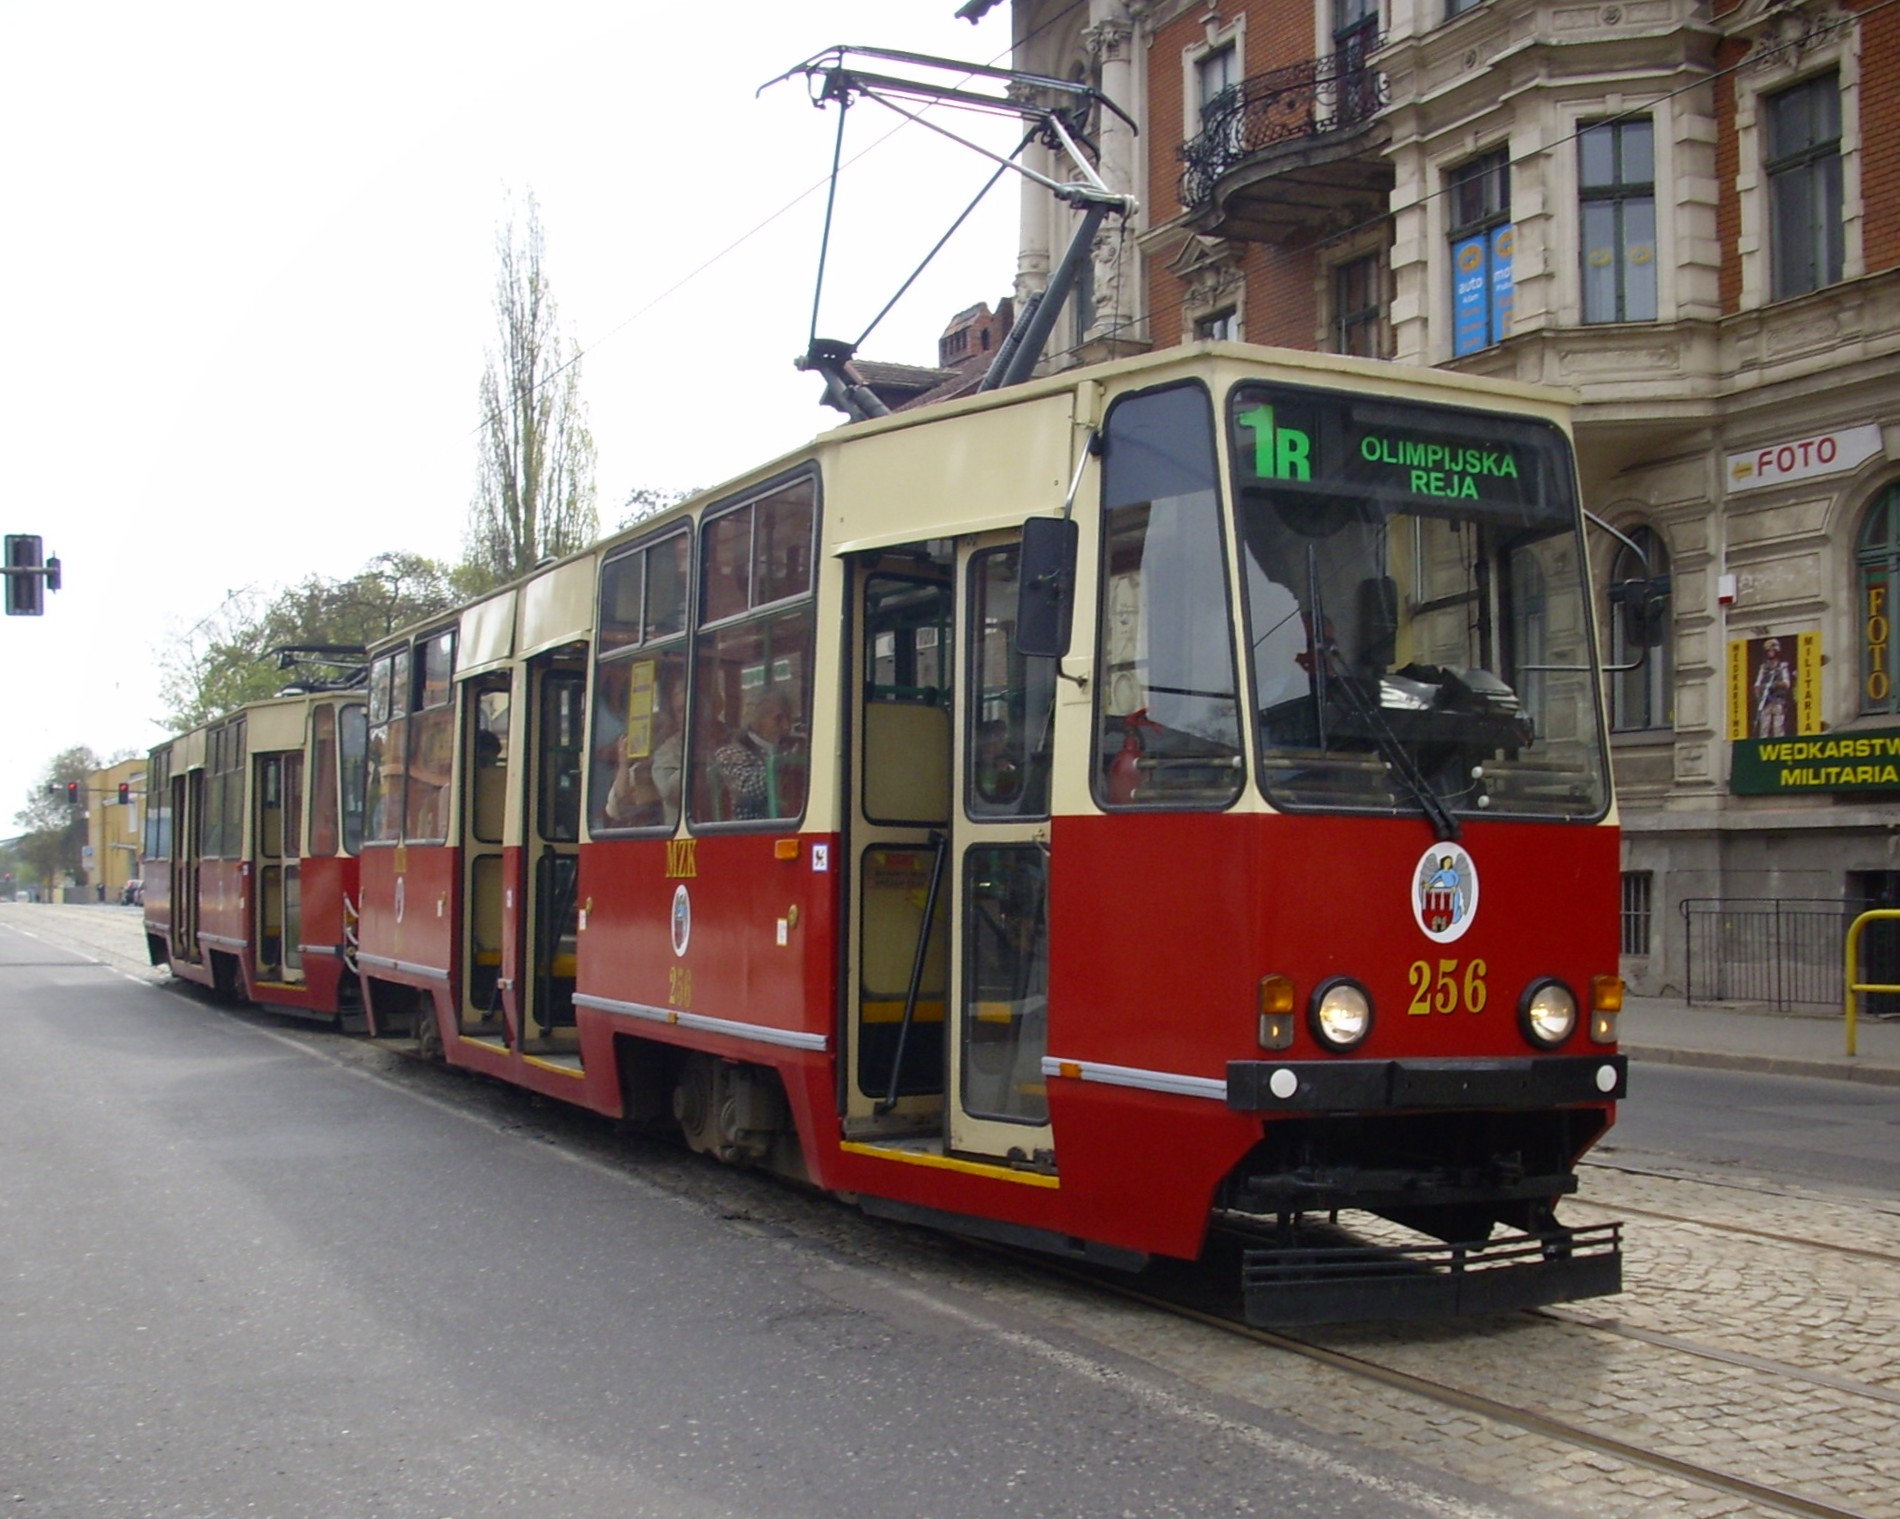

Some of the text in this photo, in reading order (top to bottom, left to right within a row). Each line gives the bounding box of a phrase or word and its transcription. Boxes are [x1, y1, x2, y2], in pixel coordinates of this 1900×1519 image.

[1458, 276, 1483, 294] auto
[1238, 404, 1311, 482] 1R
[1361, 436, 1519, 479] OLIMPIJSKA
[1757, 436, 1837, 477] FOTO
[1411, 469, 1479, 500] REJA
[1867, 588, 1889, 699] FOTO
[1803, 636, 1814, 732] MILITARIA
[1780, 765, 1899, 786] MILITARIA
[665, 839, 697, 878] MZK
[668, 966, 692, 1008] 256
[1408, 959, 1488, 1015] 256
